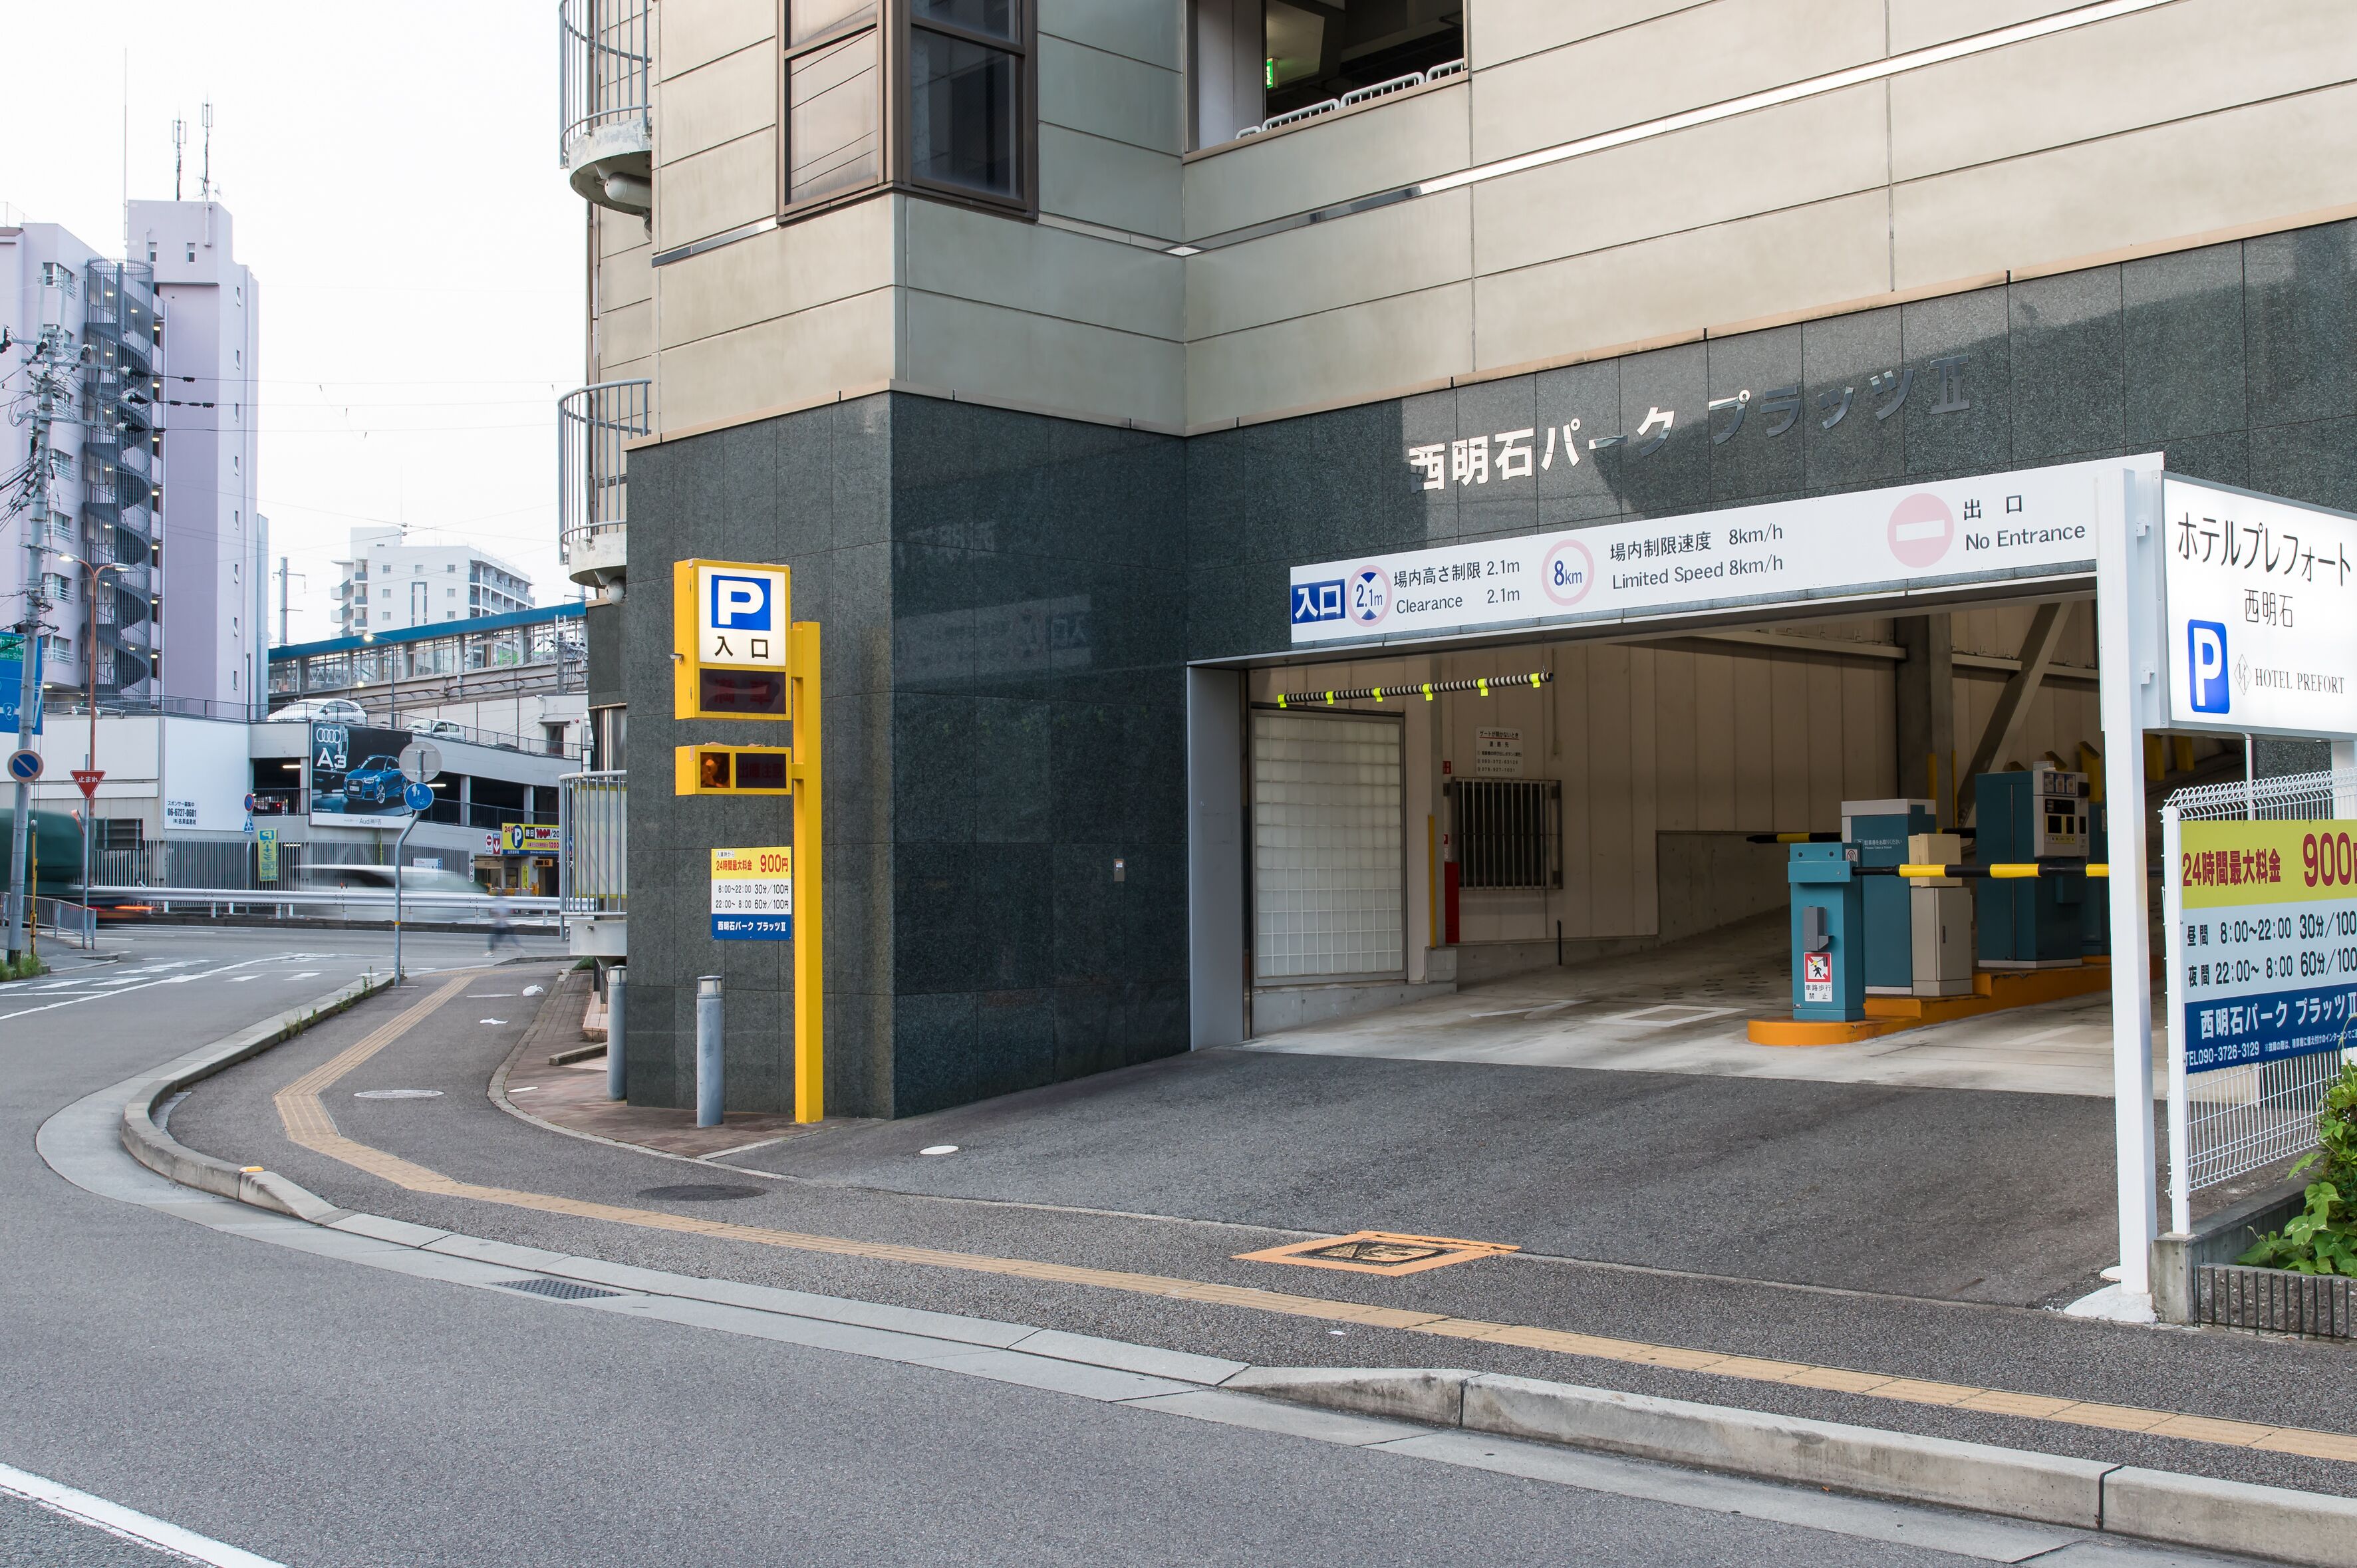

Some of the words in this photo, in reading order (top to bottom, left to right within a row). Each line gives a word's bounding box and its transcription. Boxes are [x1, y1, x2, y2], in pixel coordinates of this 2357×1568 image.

[1409, 406, 1675, 494] 西明石パーク
[1963, 494, 2022, 521] 出口
[1610, 531, 1711, 562] 場内制限速度
[1729, 523, 1782, 545] 8km/h
[1965, 533, 1990, 551] No
[1997, 525, 2086, 547] Entrance
[2177, 512, 2350, 587] ホテルプレフォート
[1394, 561, 1480, 588] 場内高さ制限
[1486, 560, 1520, 576] 2.1m
[1554, 559, 1583, 587] 8km
[1613, 569, 1668, 590] Limited
[1675, 562, 1723, 583] Speed
[1729, 554, 1783, 576] 8km/h
[718, 579, 764, 625] P
[1295, 585, 1341, 619] 入口
[1356, 583, 1383, 608] 2.1m
[1397, 596, 1463, 614] Clearance
[1486, 588, 1520, 604] 2.1m
[2244, 588, 2293, 628] 西明石
[714, 636, 769, 659] 入口
[2193, 626, 2223, 708] P
[2255, 668, 2292, 689] HOTEL
[2296, 672, 2344, 694] PREFORT
[7, 706, 11, 716] 2
[317, 747, 347, 769] A3
[167, 807, 197, 817] 06-6727-0601
[716, 859, 752, 871] 24時間最大料金
[760, 854, 788, 872] 900円
[2182, 848, 2281, 886] 24時間最大料金
[2302, 832, 2357, 888] 900
[718, 921, 754, 931] 西明石パーク
[2187, 924, 2208, 947] 昼間
[2188, 964, 2209, 987] 夜間
[2200, 1001, 2288, 1039] 西明石パーク
